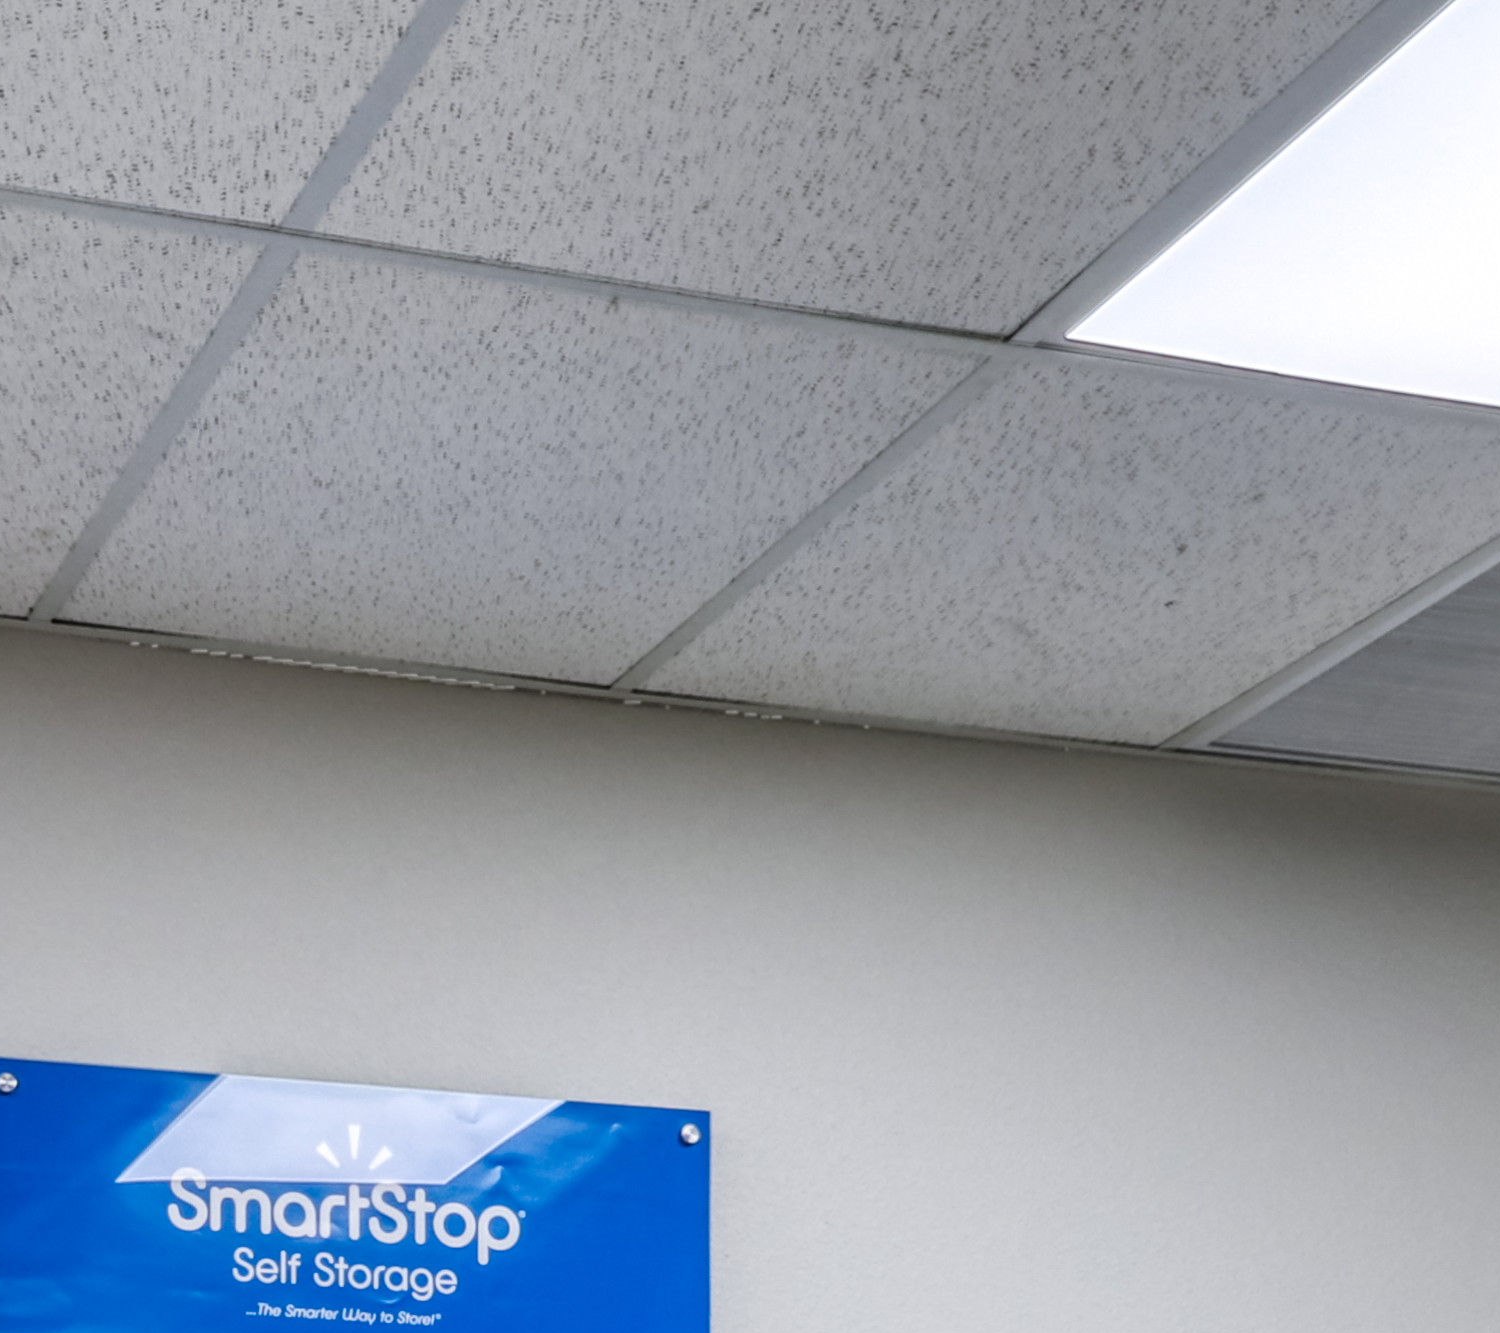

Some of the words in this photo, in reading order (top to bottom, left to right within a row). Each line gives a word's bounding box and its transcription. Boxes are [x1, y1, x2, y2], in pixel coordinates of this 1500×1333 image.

[167, 1167, 521, 1266] SmartStop
[232, 1247, 301, 1284] Self
[313, 1252, 458, 1301] Storage
[285, 1304, 339, 1320] Smarter
[342, 1308, 376, 1325] Way
[380, 1310, 394, 1323] to
